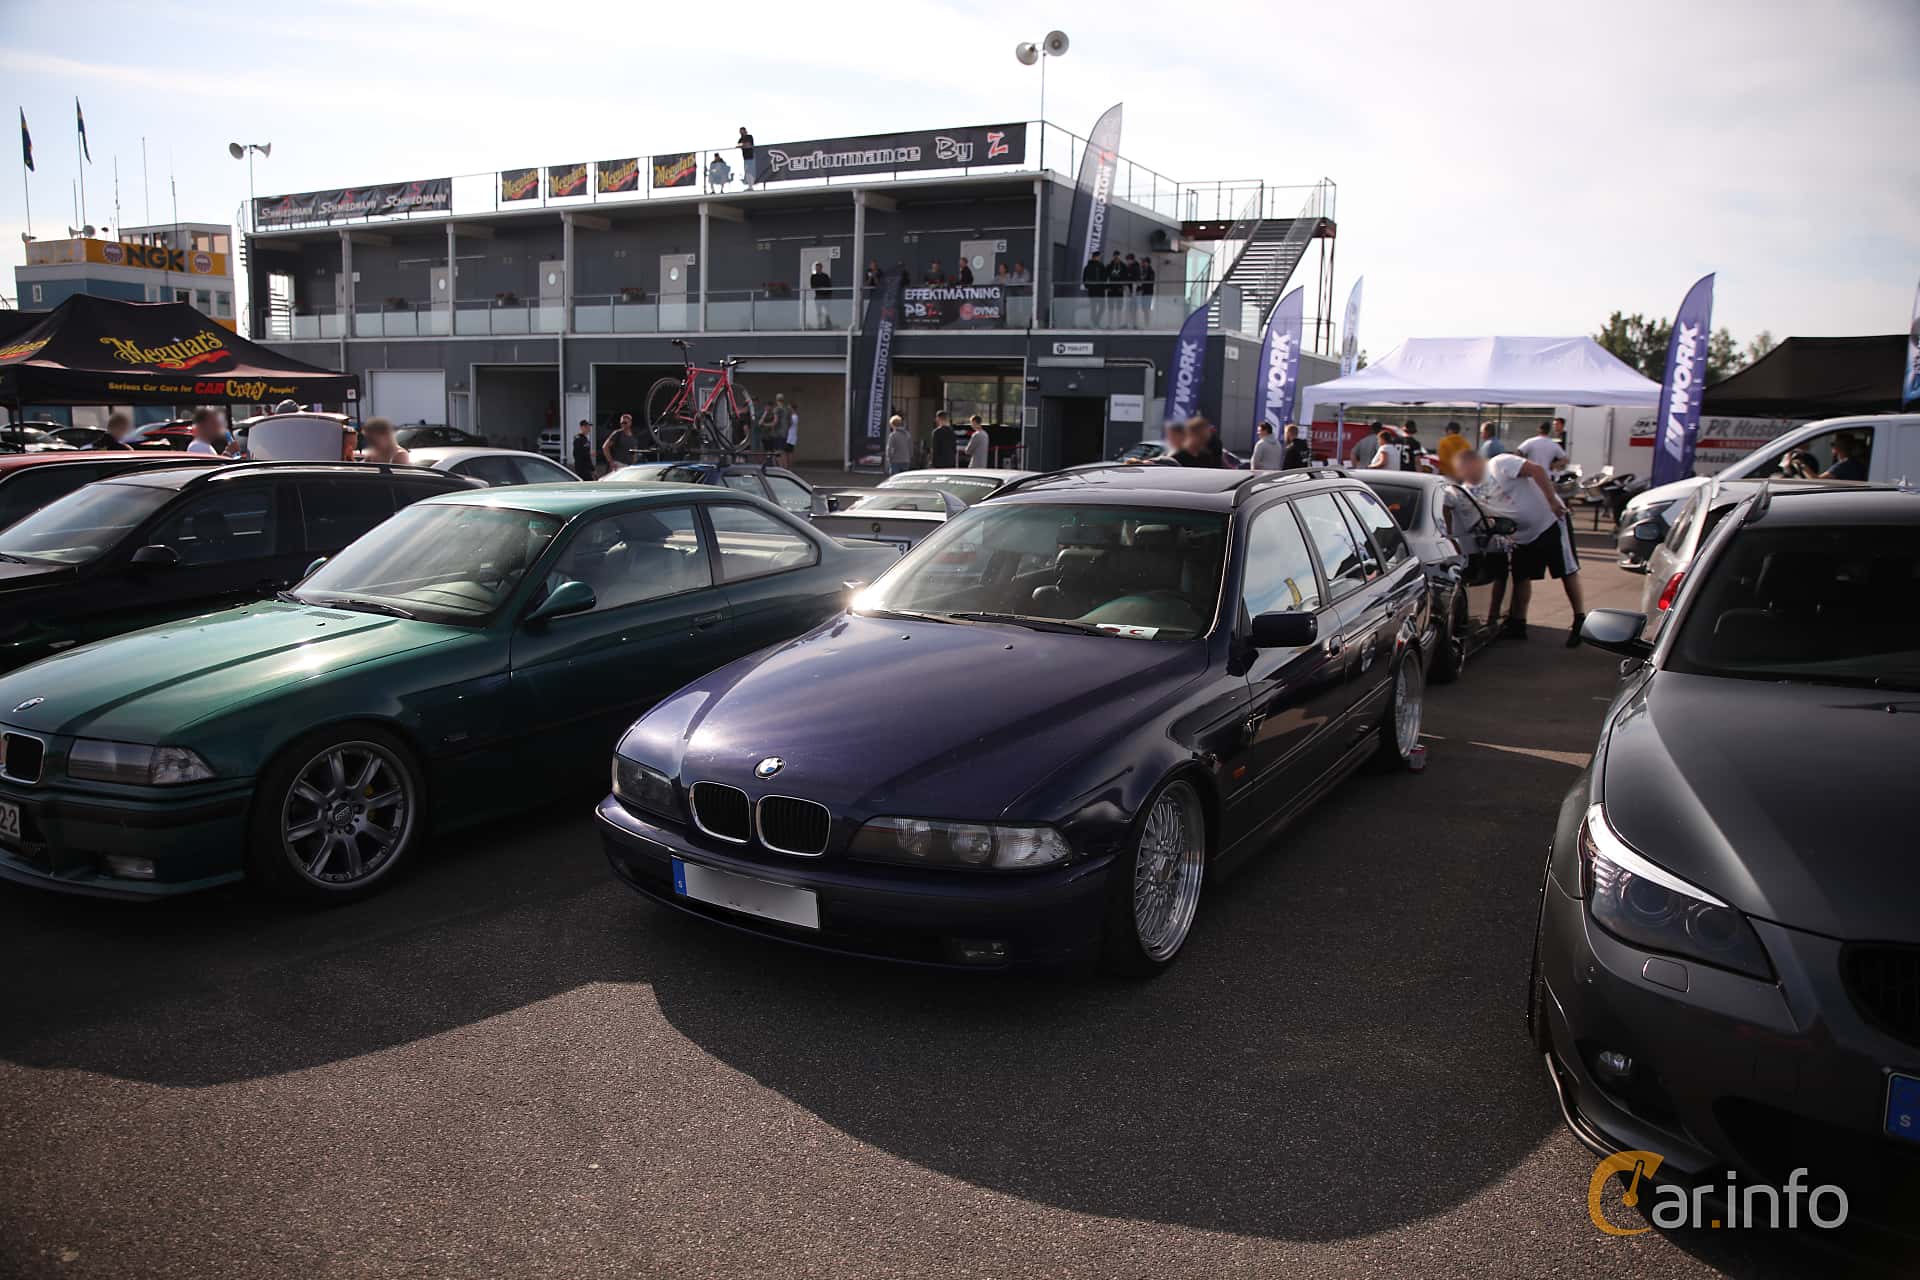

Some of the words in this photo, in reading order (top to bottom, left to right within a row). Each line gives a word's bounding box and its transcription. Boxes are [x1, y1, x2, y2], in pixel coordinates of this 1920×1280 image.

[768, 146, 921, 172] Performance
[935, 136, 973, 162] By
[987, 132, 1009, 159] Z
[126, 243, 185, 273] NGK
[904, 285, 1001, 301] EFFEKTMÄTNING
[871, 319, 893, 438] MOTOROPTIMERING
[1175, 340, 1197, 403] WORK
[1265, 330, 1291, 408] WORK
[1669, 321, 1699, 414] WORK
[108, 382, 140, 392] Serious
[143, 383, 157, 392] Car
[159, 383, 179, 392] Care
[180, 383, 192, 392] for
[194, 381, 225, 395] CAR
[225, 379, 268, 401] Crazy
[1705, 418, 1730, 436] PR
[1899, 1114, 1912, 1128] S
